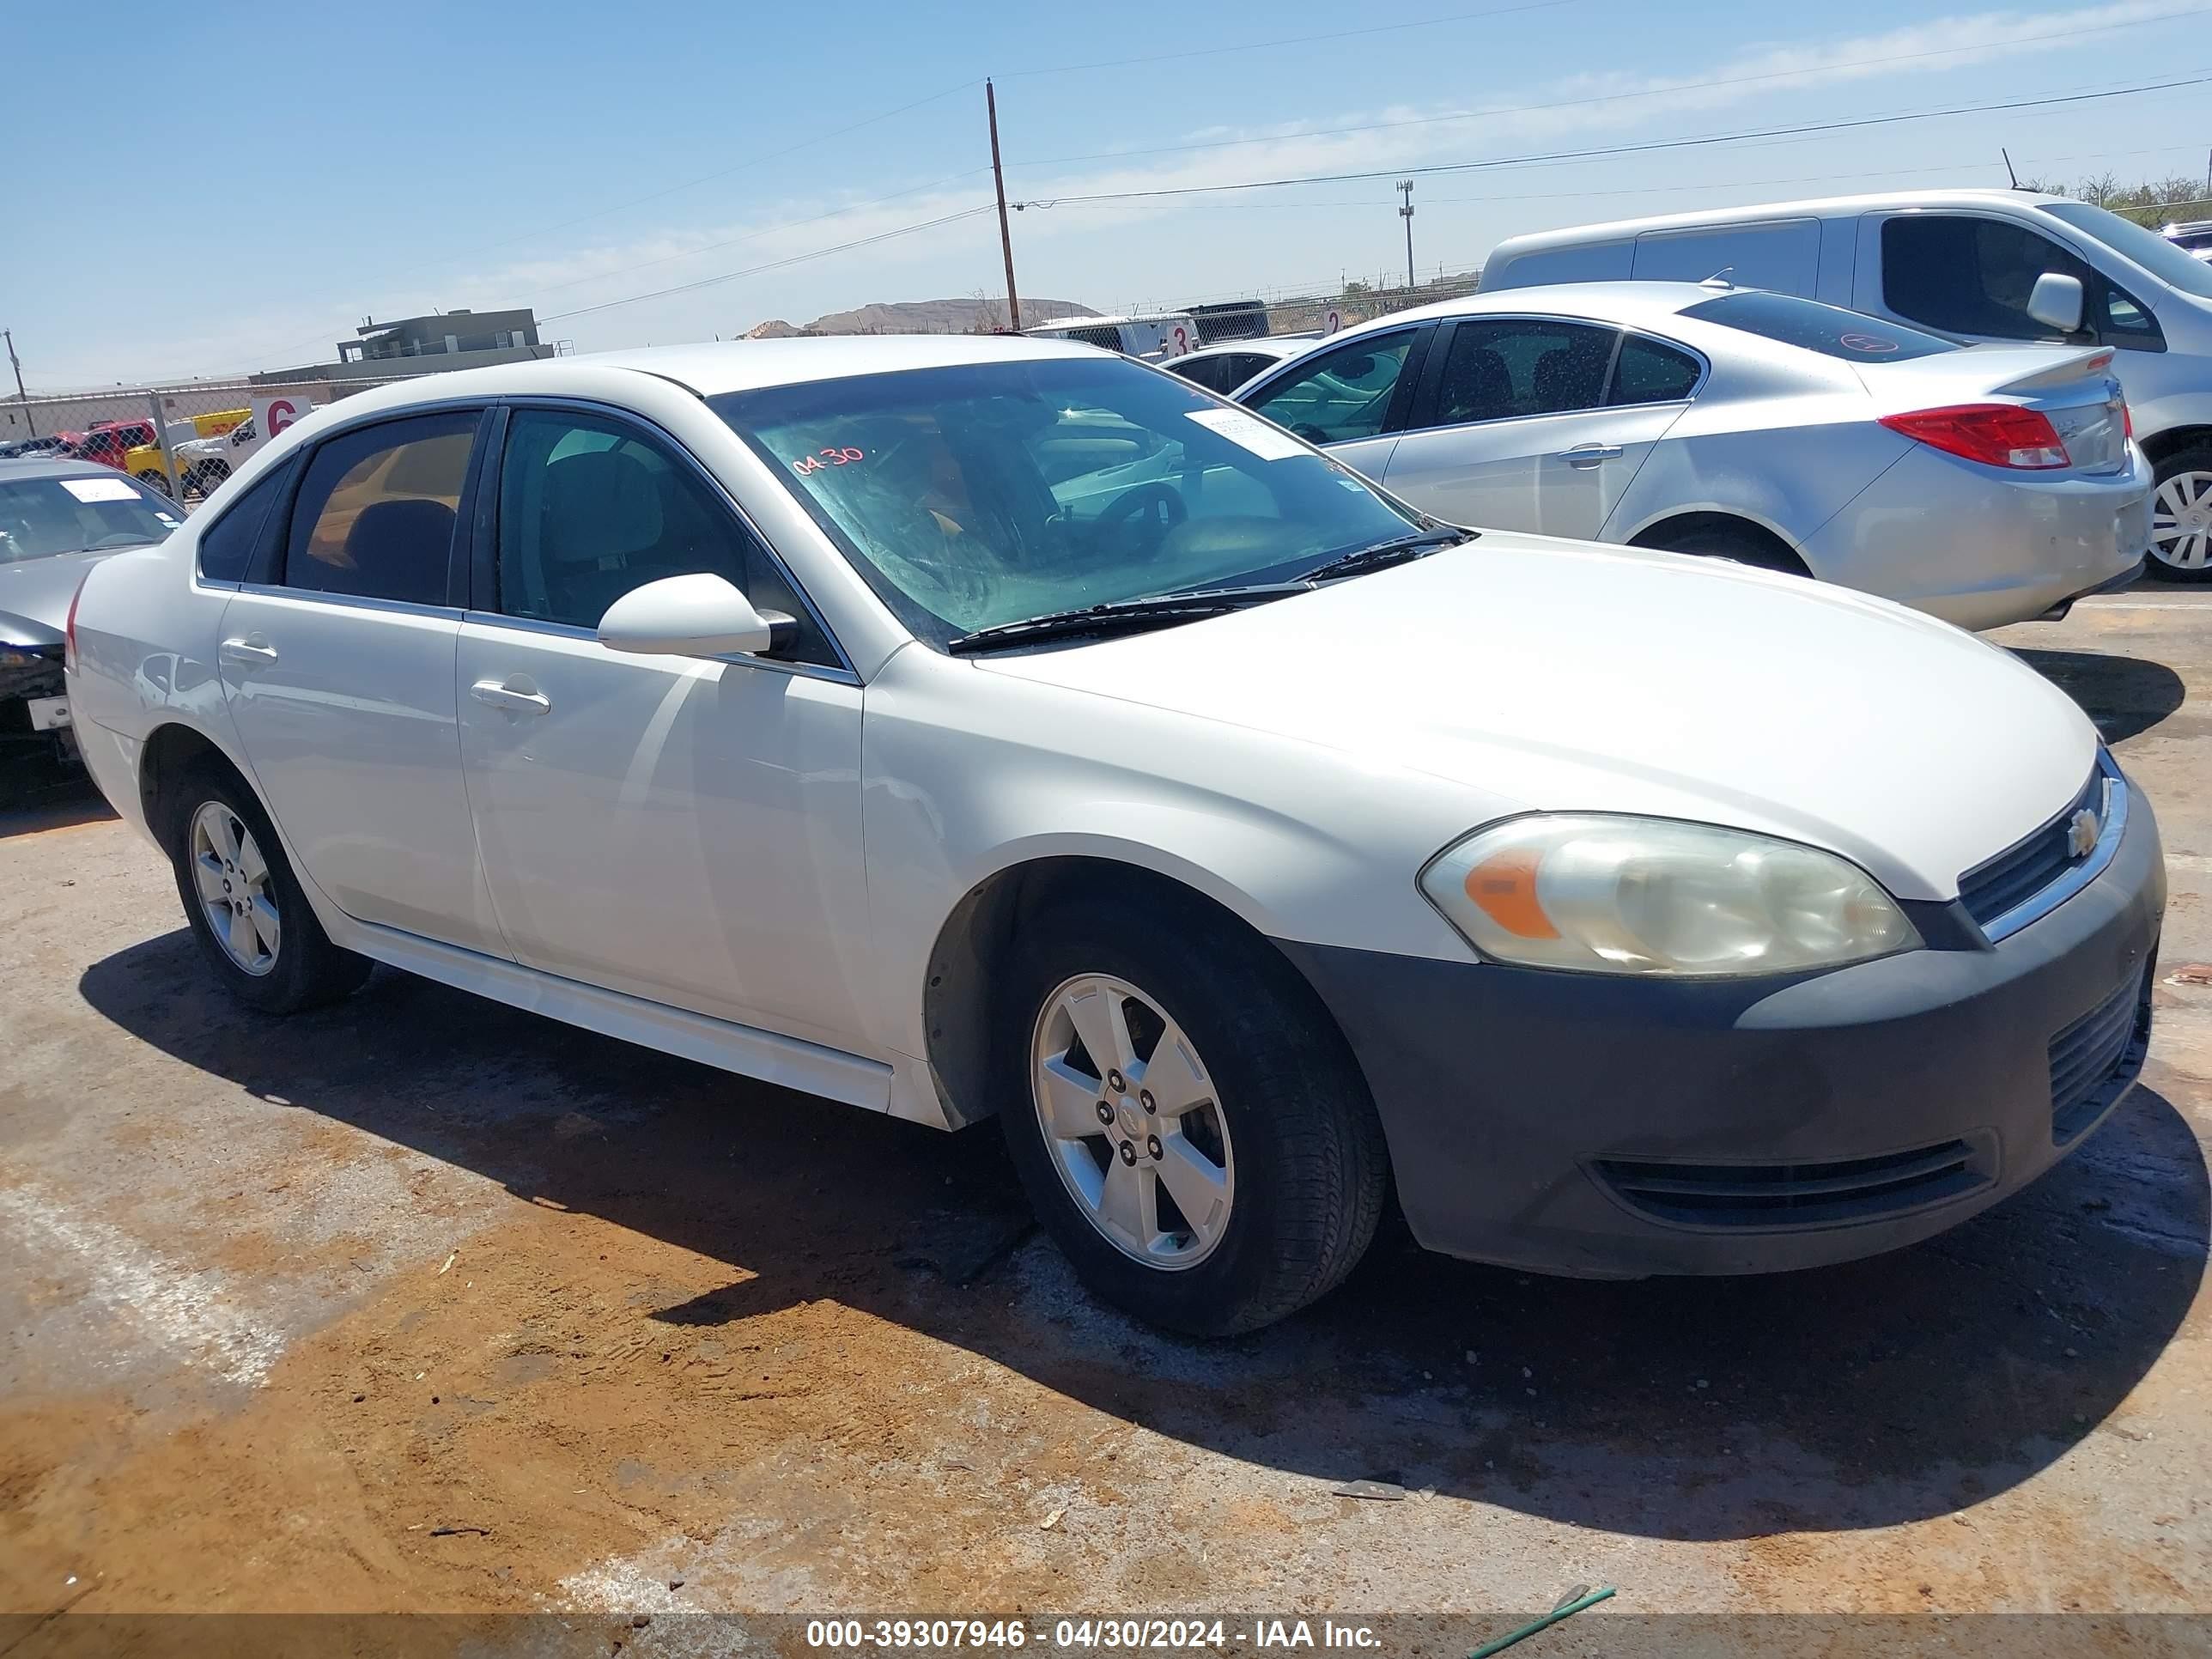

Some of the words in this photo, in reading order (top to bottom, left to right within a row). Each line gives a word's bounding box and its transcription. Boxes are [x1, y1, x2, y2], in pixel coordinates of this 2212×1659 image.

[1174, 327, 1188, 357] 3
[267, 400, 296, 440] 6
[793, 447, 864, 477] 04-30
